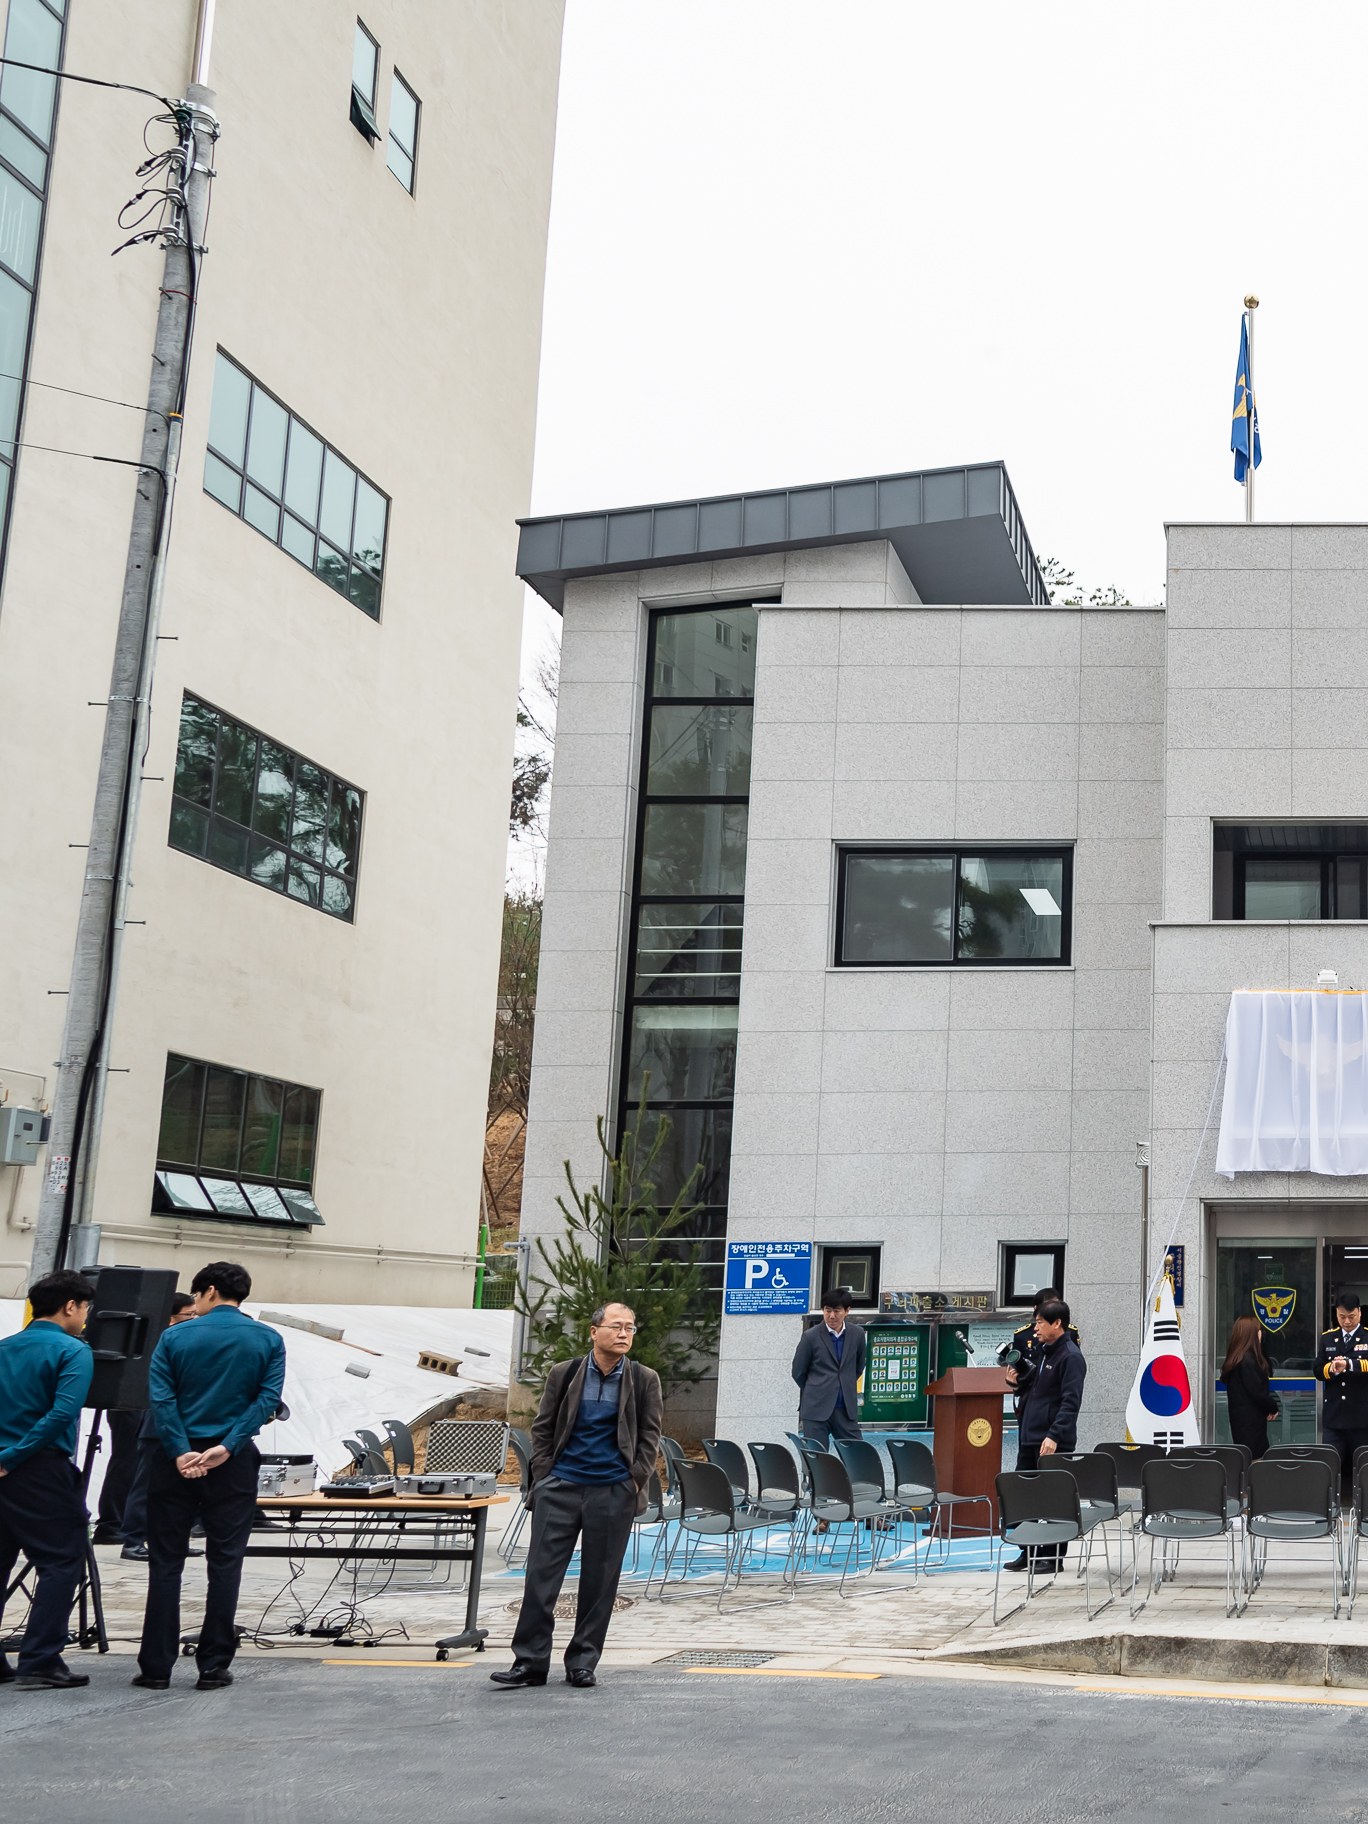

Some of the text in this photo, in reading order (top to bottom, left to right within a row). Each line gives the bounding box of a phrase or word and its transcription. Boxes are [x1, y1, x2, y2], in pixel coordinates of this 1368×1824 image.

[731, 1243, 809, 1254] 장애인전용주차구역
[744, 1259, 770, 1289] P
[883, 1295, 988, 1310] 구의파출소 게시판
